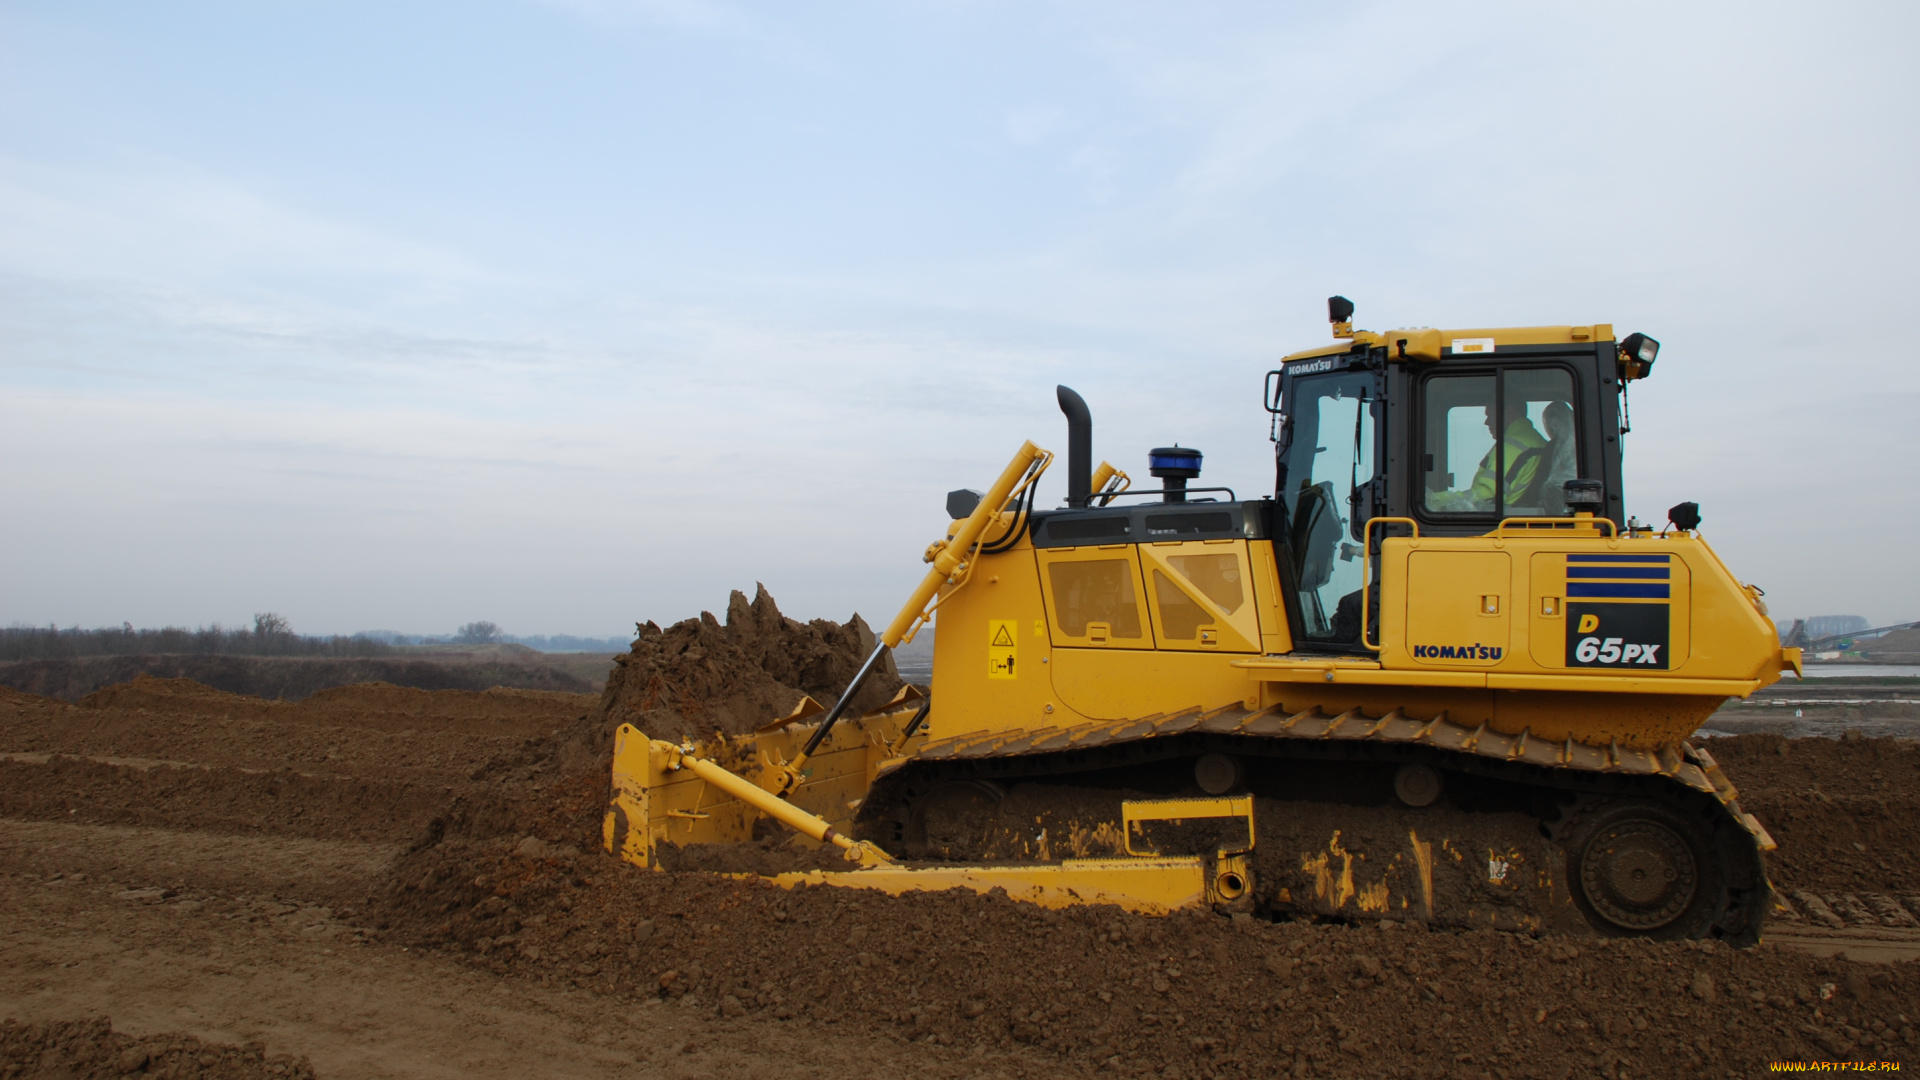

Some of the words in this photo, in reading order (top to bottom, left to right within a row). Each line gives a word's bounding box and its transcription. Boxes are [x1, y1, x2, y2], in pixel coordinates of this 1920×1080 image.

[1288, 360, 1332, 375] KOMATSU
[1577, 614, 1600, 634] D
[1413, 642, 1503, 660] KOMATSU
[1575, 636, 1661, 664] 65PX
